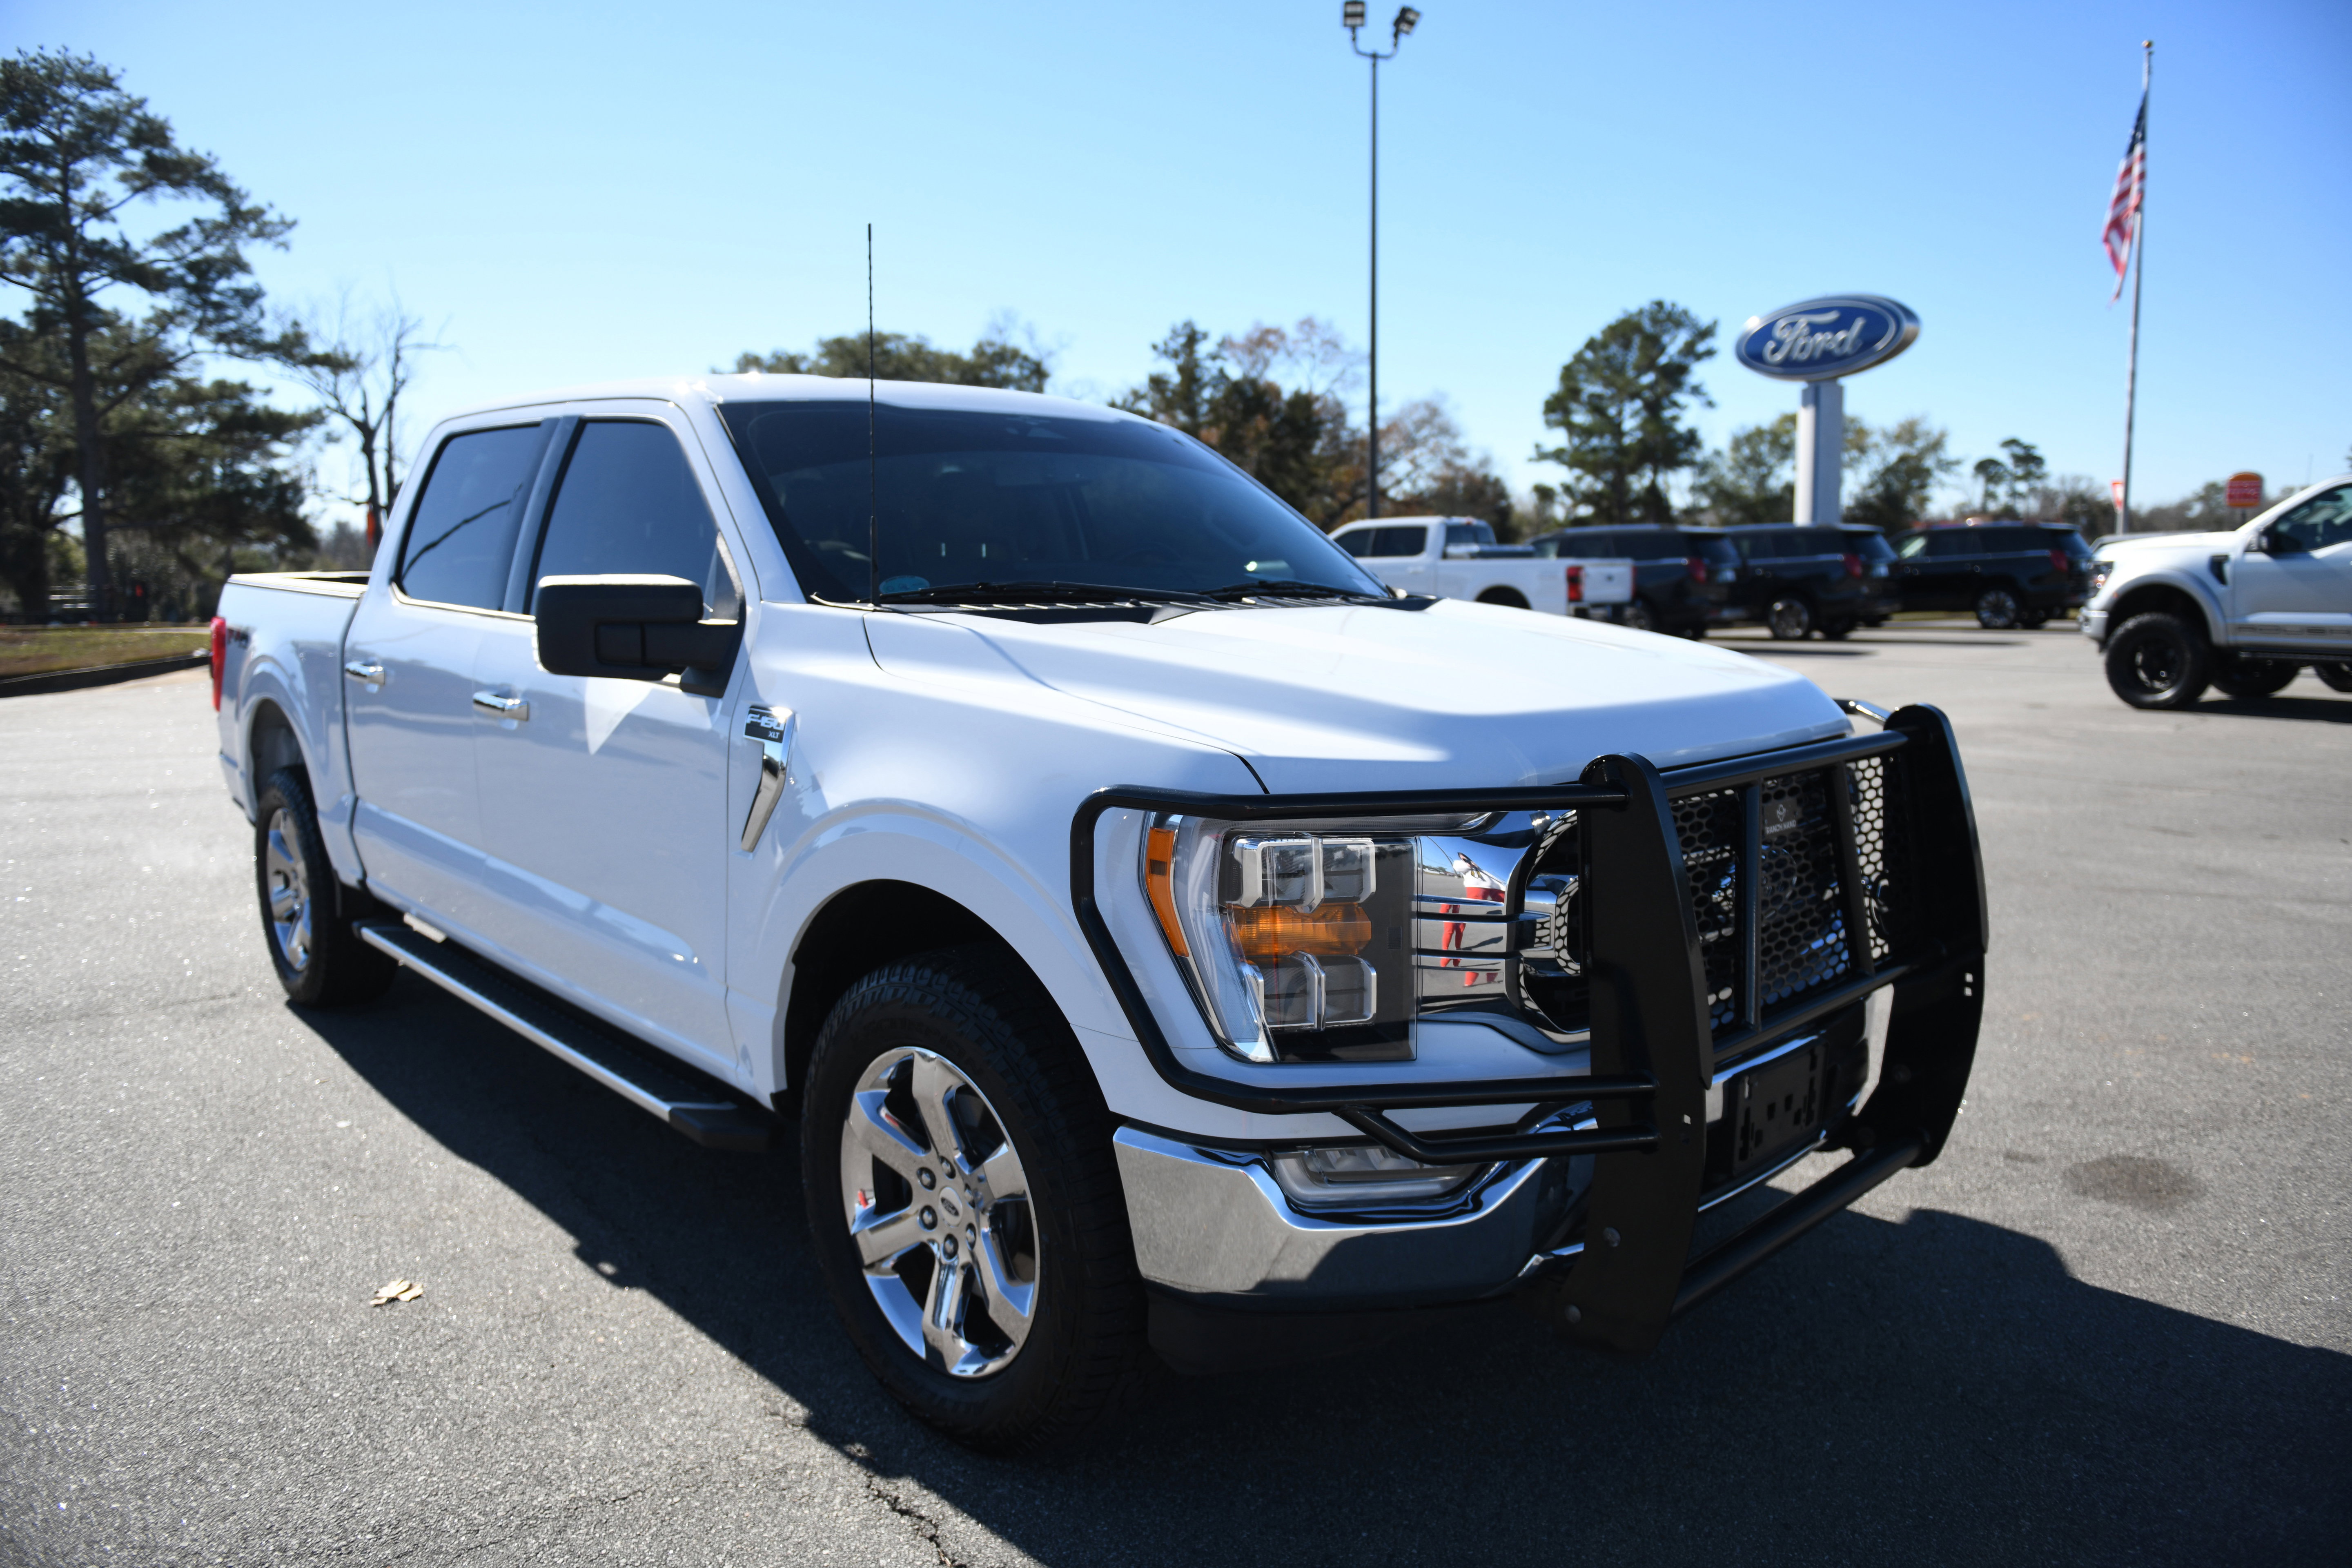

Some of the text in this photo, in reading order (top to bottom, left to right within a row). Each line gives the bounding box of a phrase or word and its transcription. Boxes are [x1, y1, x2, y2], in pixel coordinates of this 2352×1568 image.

[1762, 310, 1865, 364] Ford
[1765, 820, 1796, 835] RANCH HAND
